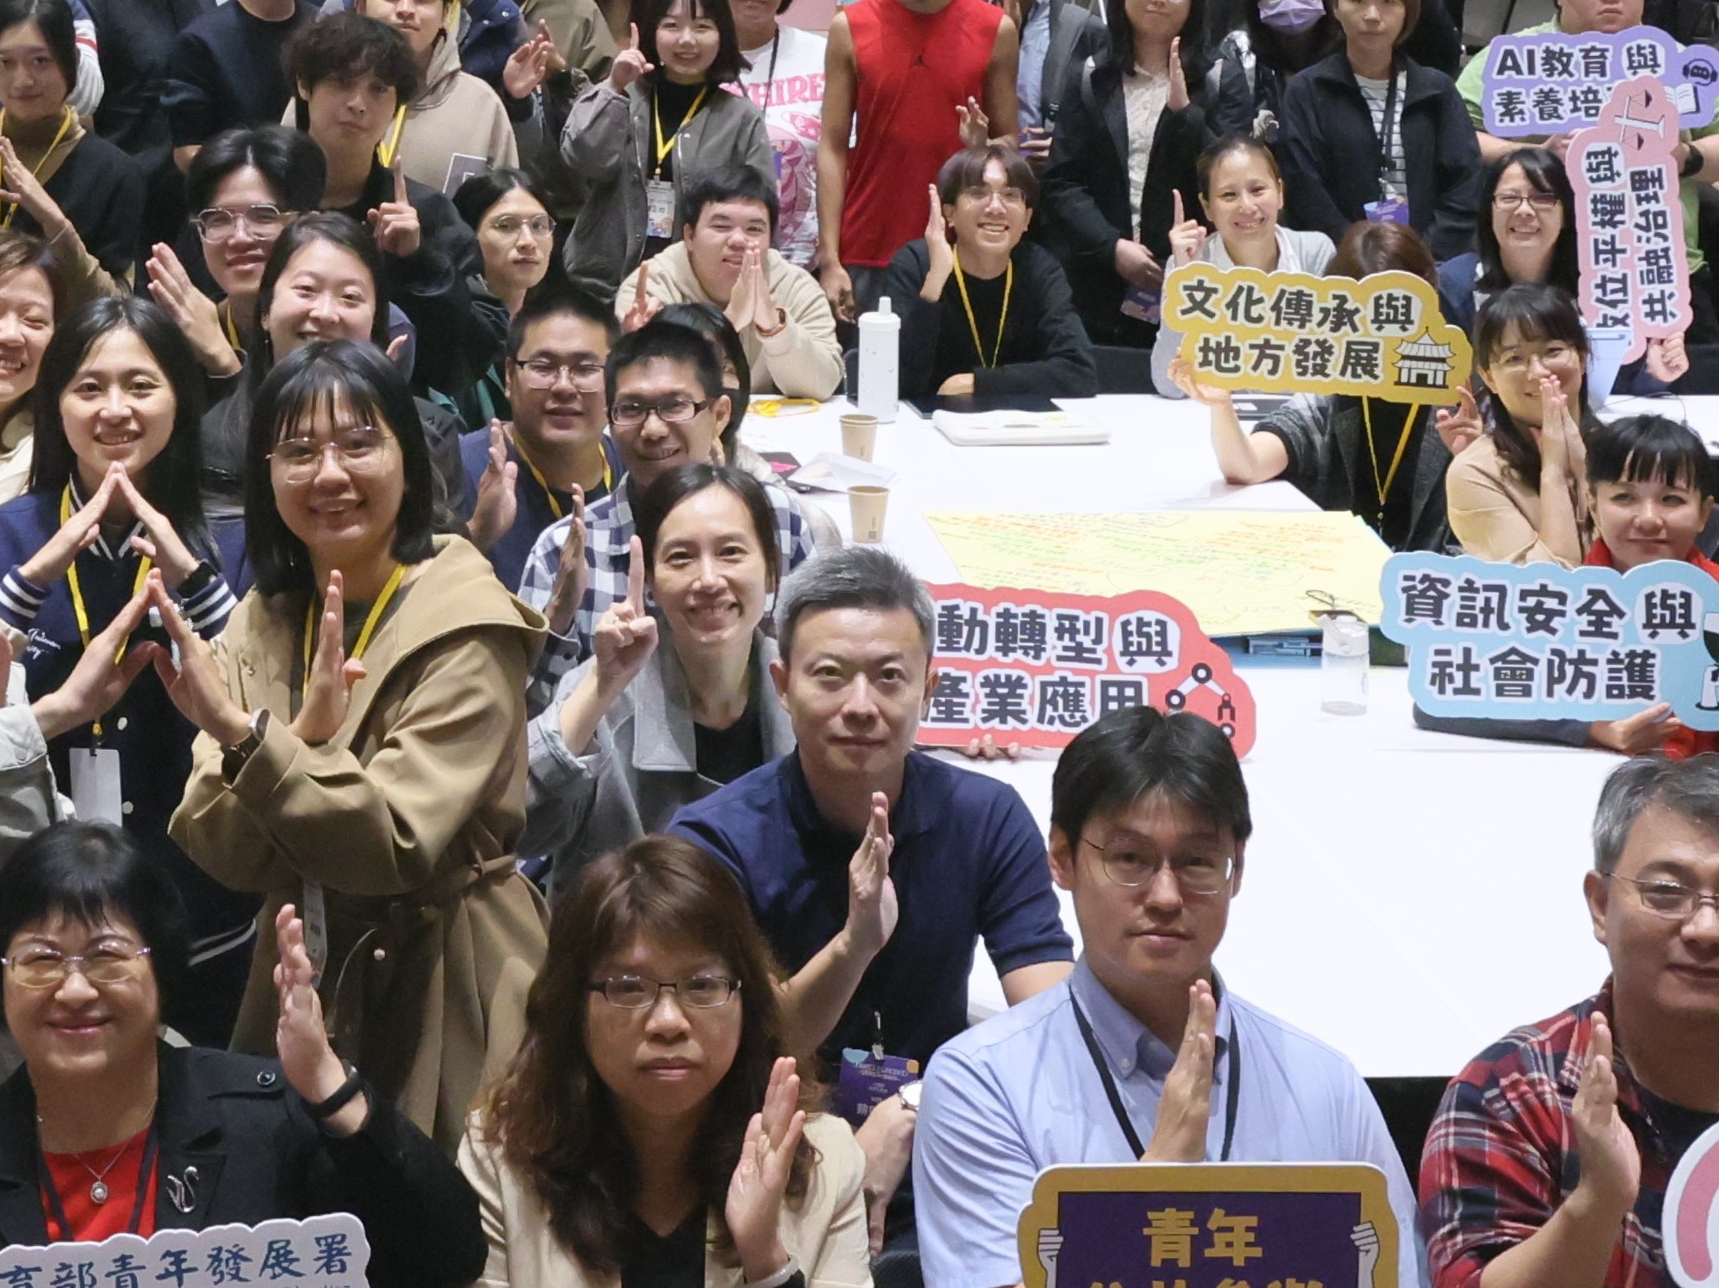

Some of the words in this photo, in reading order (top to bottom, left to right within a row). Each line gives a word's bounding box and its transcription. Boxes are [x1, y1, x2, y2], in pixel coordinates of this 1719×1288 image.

[1494, 85, 1612, 125] 素養培
[1629, 165, 1676, 323] 共融治理
[1179, 279, 1415, 333] 文化傳承與
[1198, 336, 1384, 382] 地方發展
[1399, 573, 1697, 639] 資訊安全與
[936, 602, 1173, 667] 動轉型與
[926, 672, 1148, 728] 產業應用
[1429, 648, 1659, 702] 社會防護
[1144, 1207, 1264, 1268] 青年
